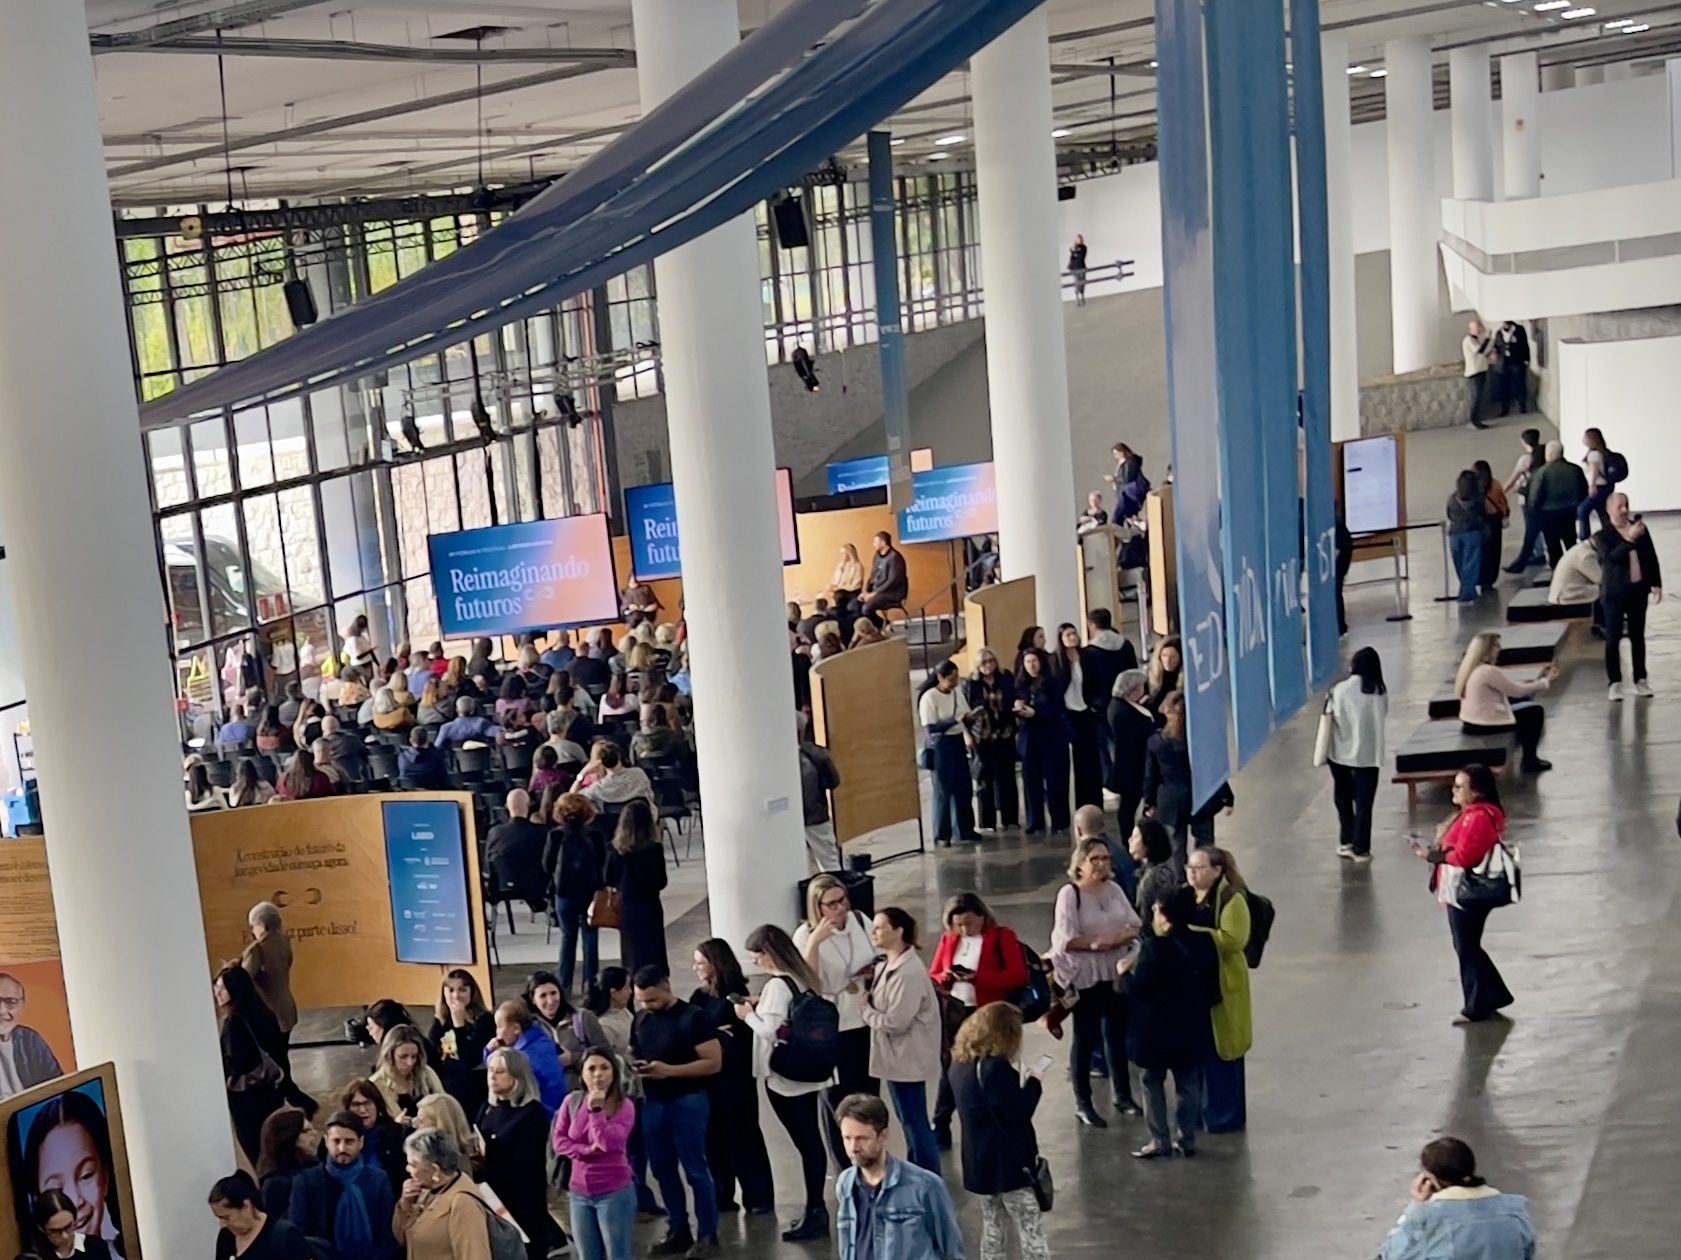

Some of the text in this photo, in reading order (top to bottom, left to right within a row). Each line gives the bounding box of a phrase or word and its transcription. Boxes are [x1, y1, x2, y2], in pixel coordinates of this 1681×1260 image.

[906, 514, 954, 533] futuros
[449, 555, 590, 593] Reimaginando
[454, 596, 523, 622] futuros
